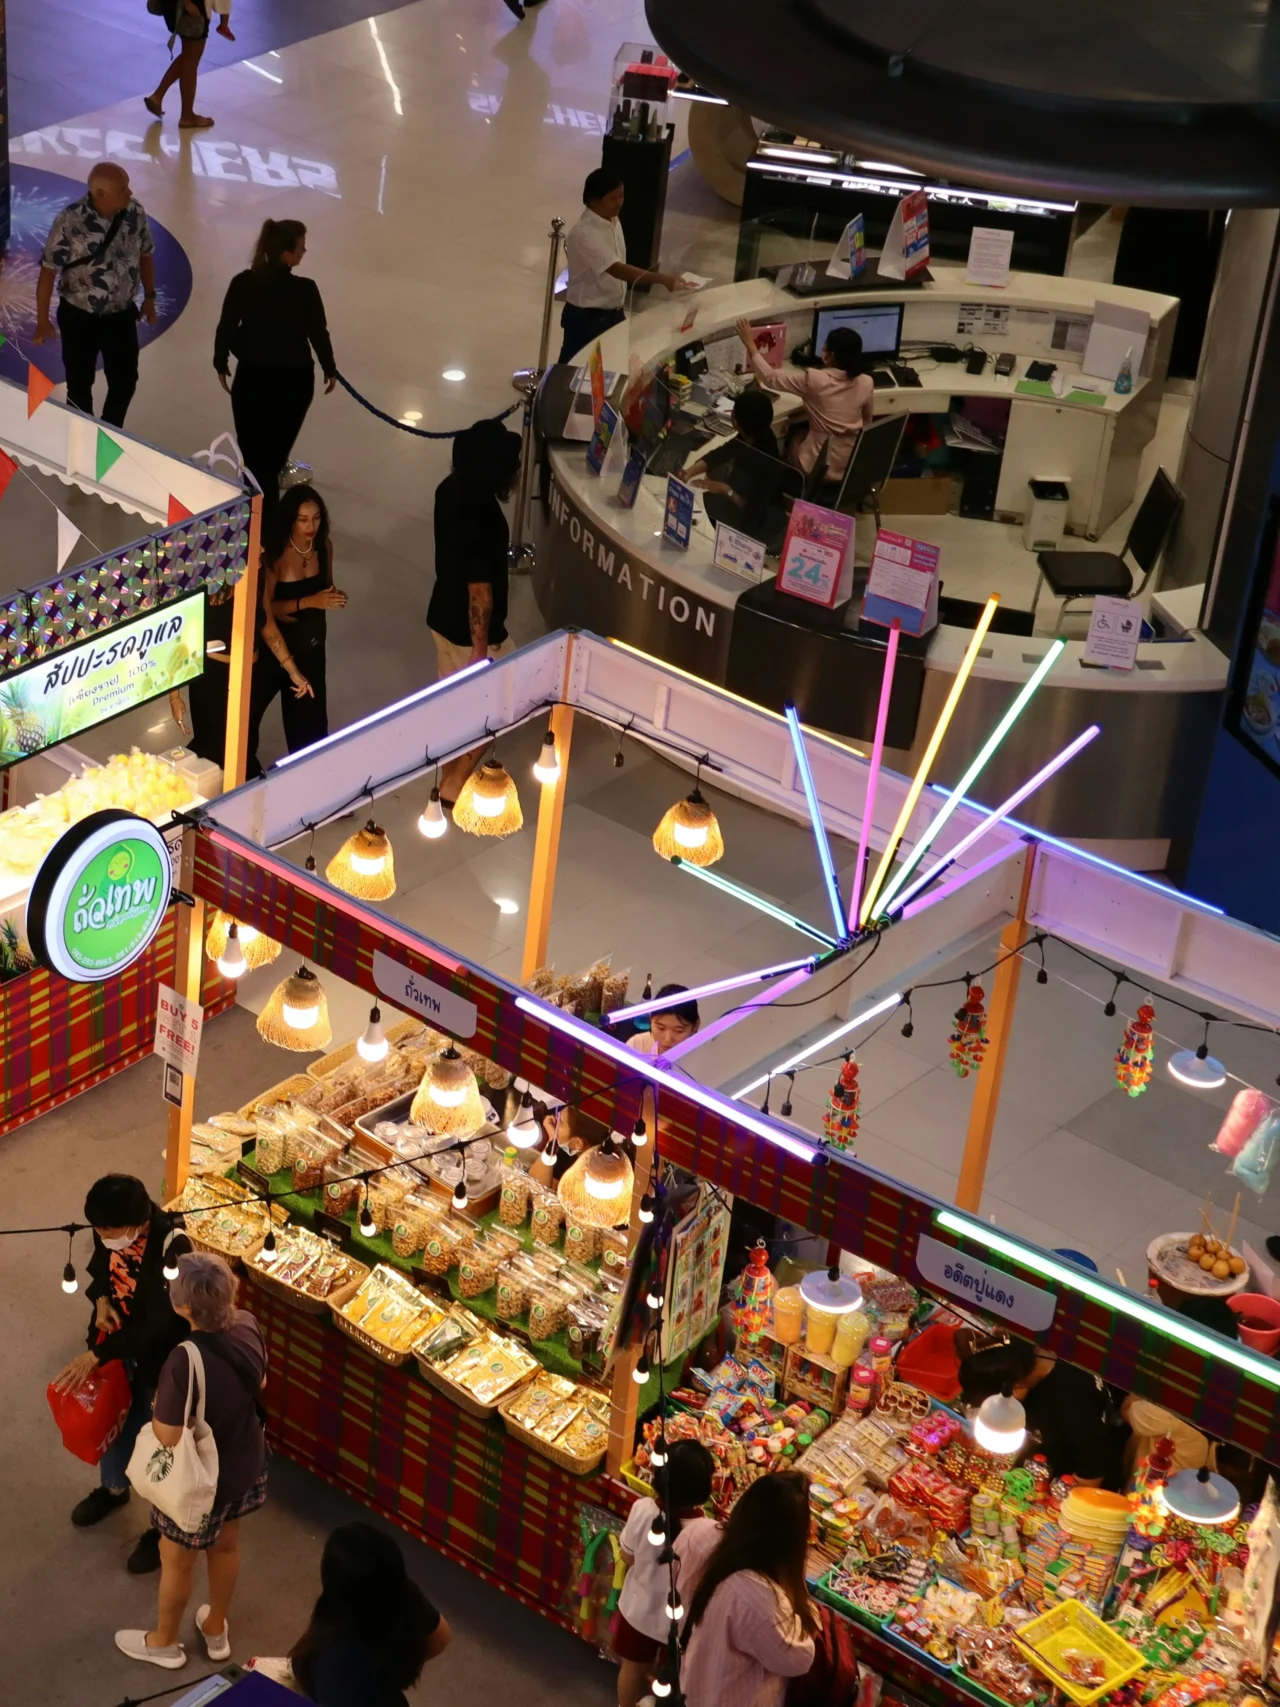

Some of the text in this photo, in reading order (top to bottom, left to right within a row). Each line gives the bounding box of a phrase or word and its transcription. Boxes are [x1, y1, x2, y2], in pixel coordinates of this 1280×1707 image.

[548, 480, 716, 638] INFORMATION
[128, 660, 156, 677] 100%
[93, 683, 134, 706] Premium
[73, 876, 158, 935] ถั่วเทพ
[405, 975, 441, 1014] ถั่วเทพ
[160, 998, 198, 1031] BUY 5
[160, 1023, 195, 1055] FREE!
[944, 1262, 1015, 1309] อดีตปู่แดง
